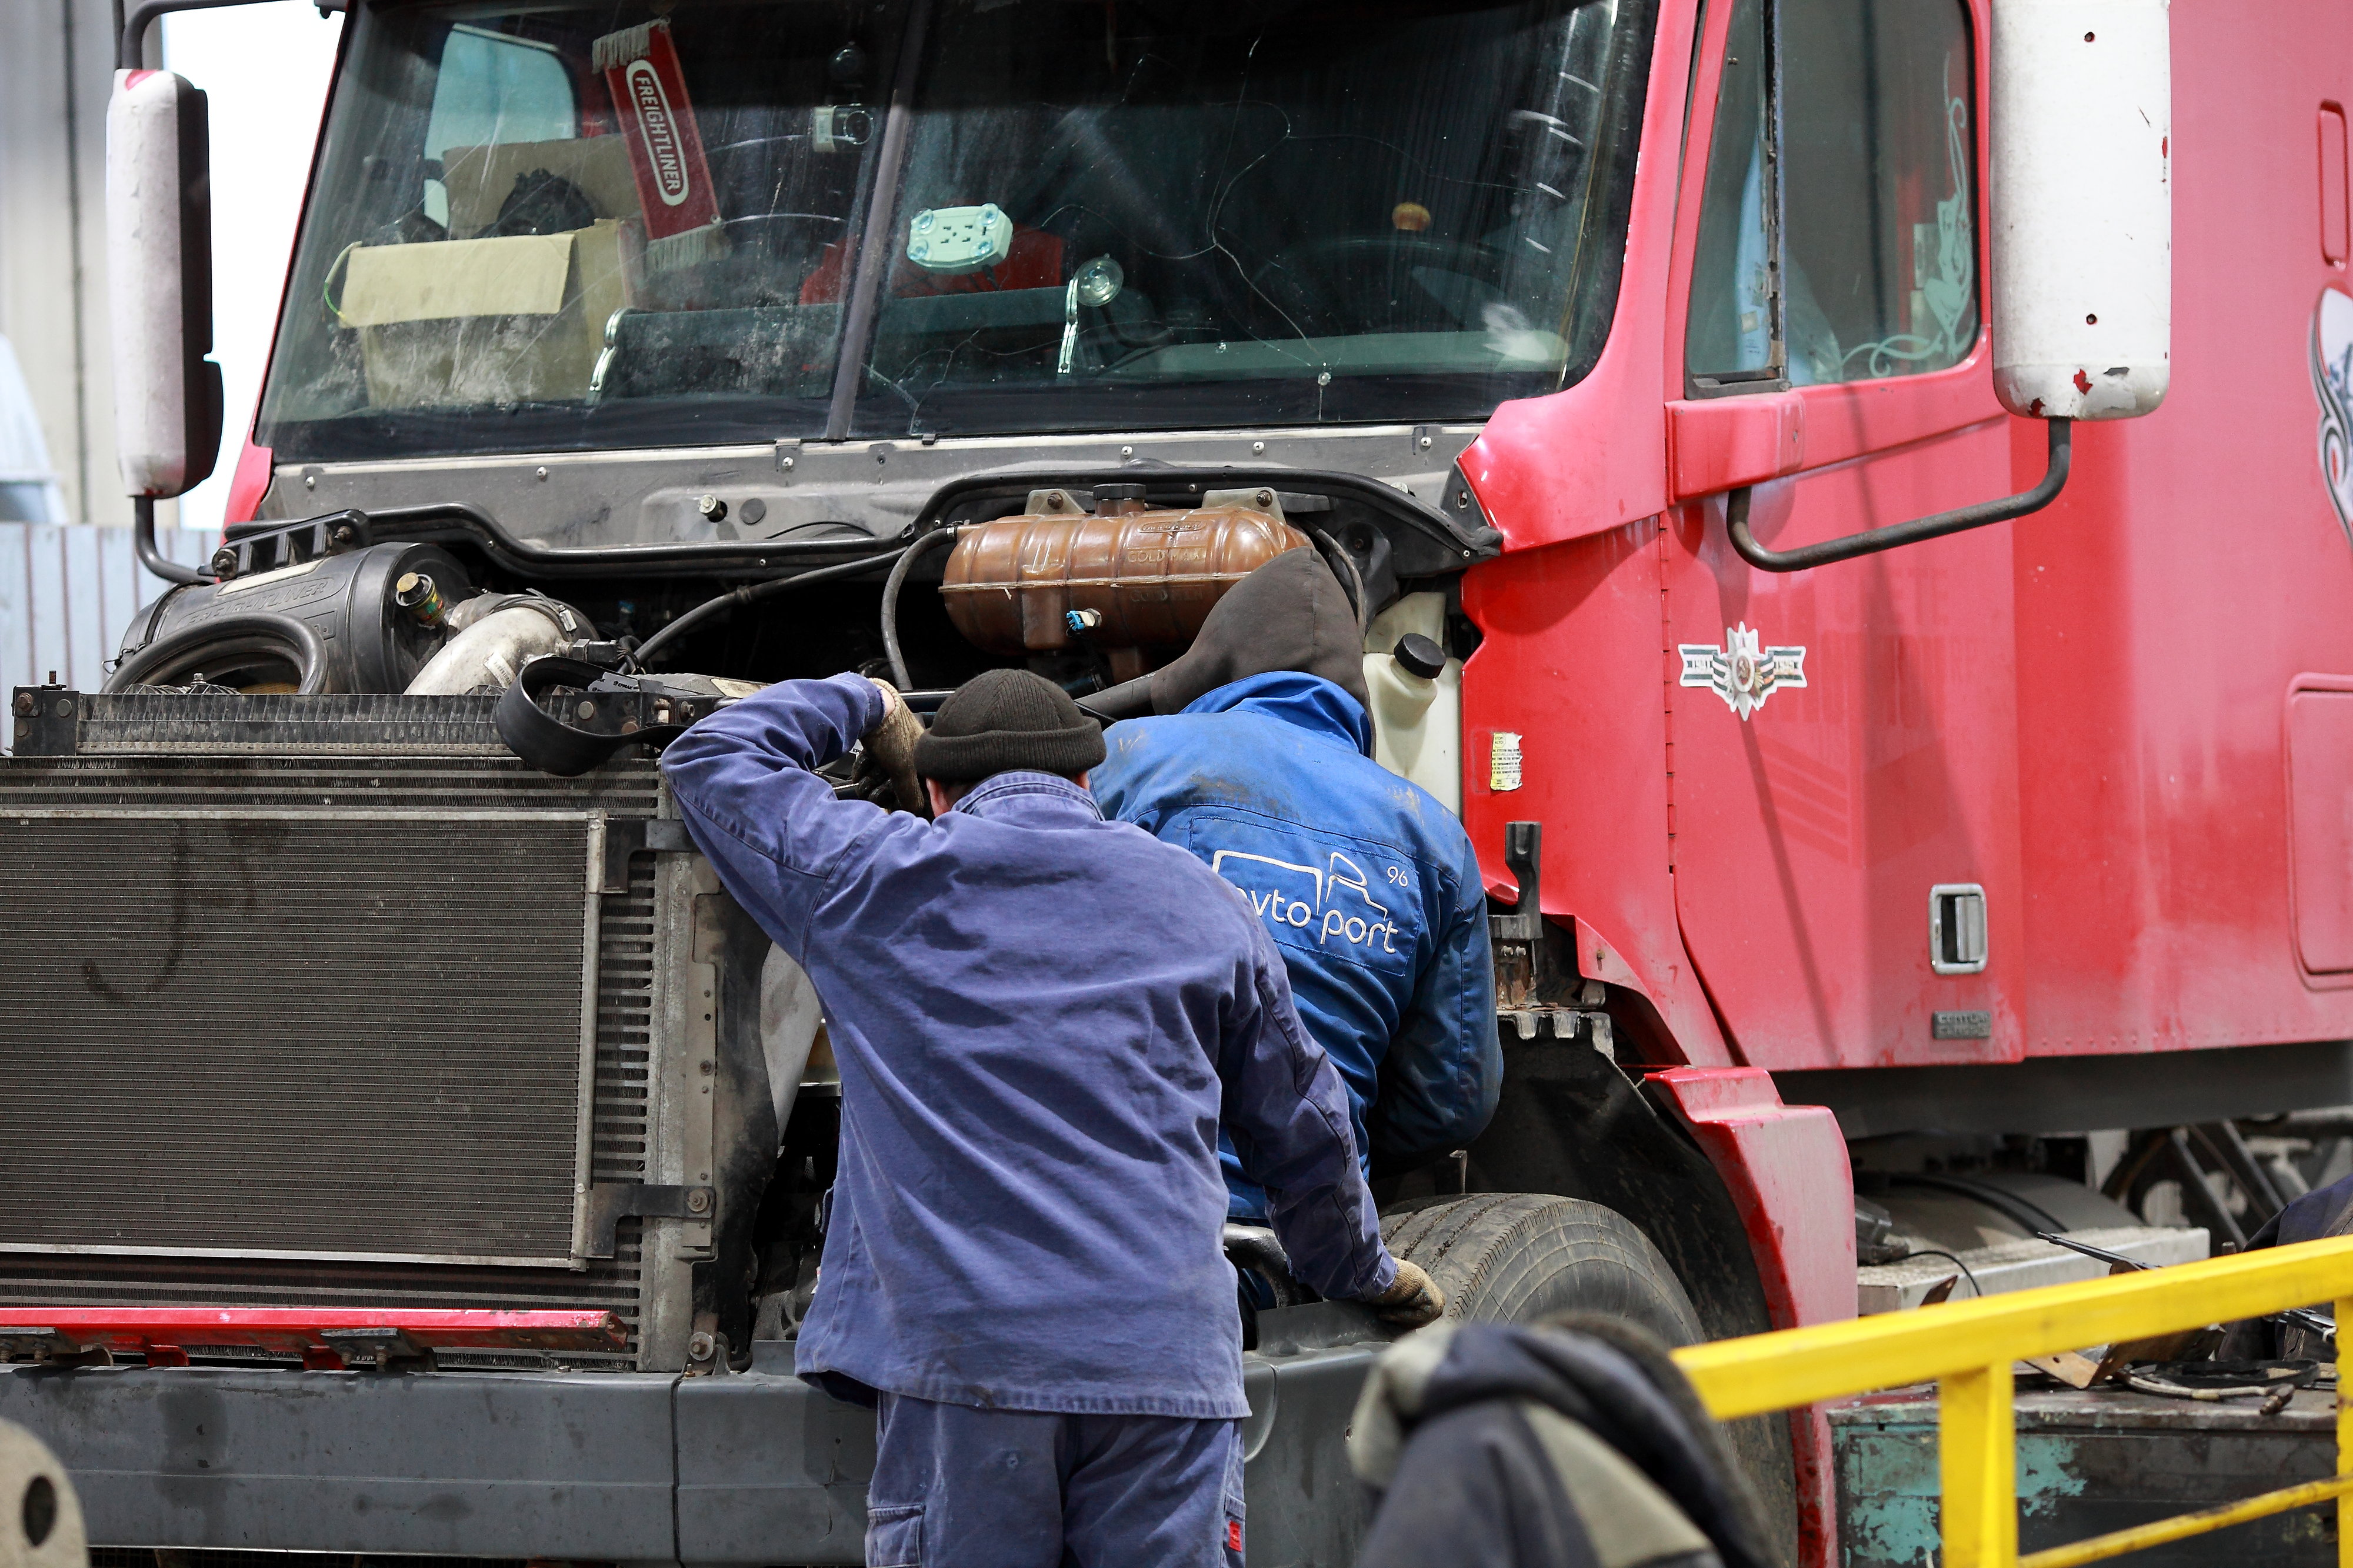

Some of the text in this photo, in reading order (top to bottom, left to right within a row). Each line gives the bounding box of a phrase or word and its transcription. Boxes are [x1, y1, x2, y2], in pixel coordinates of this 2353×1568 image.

[635, 76, 681, 191] FREIGHTLINER
[1387, 866, 1408, 888] 96
[1320, 909, 1399, 953] port
